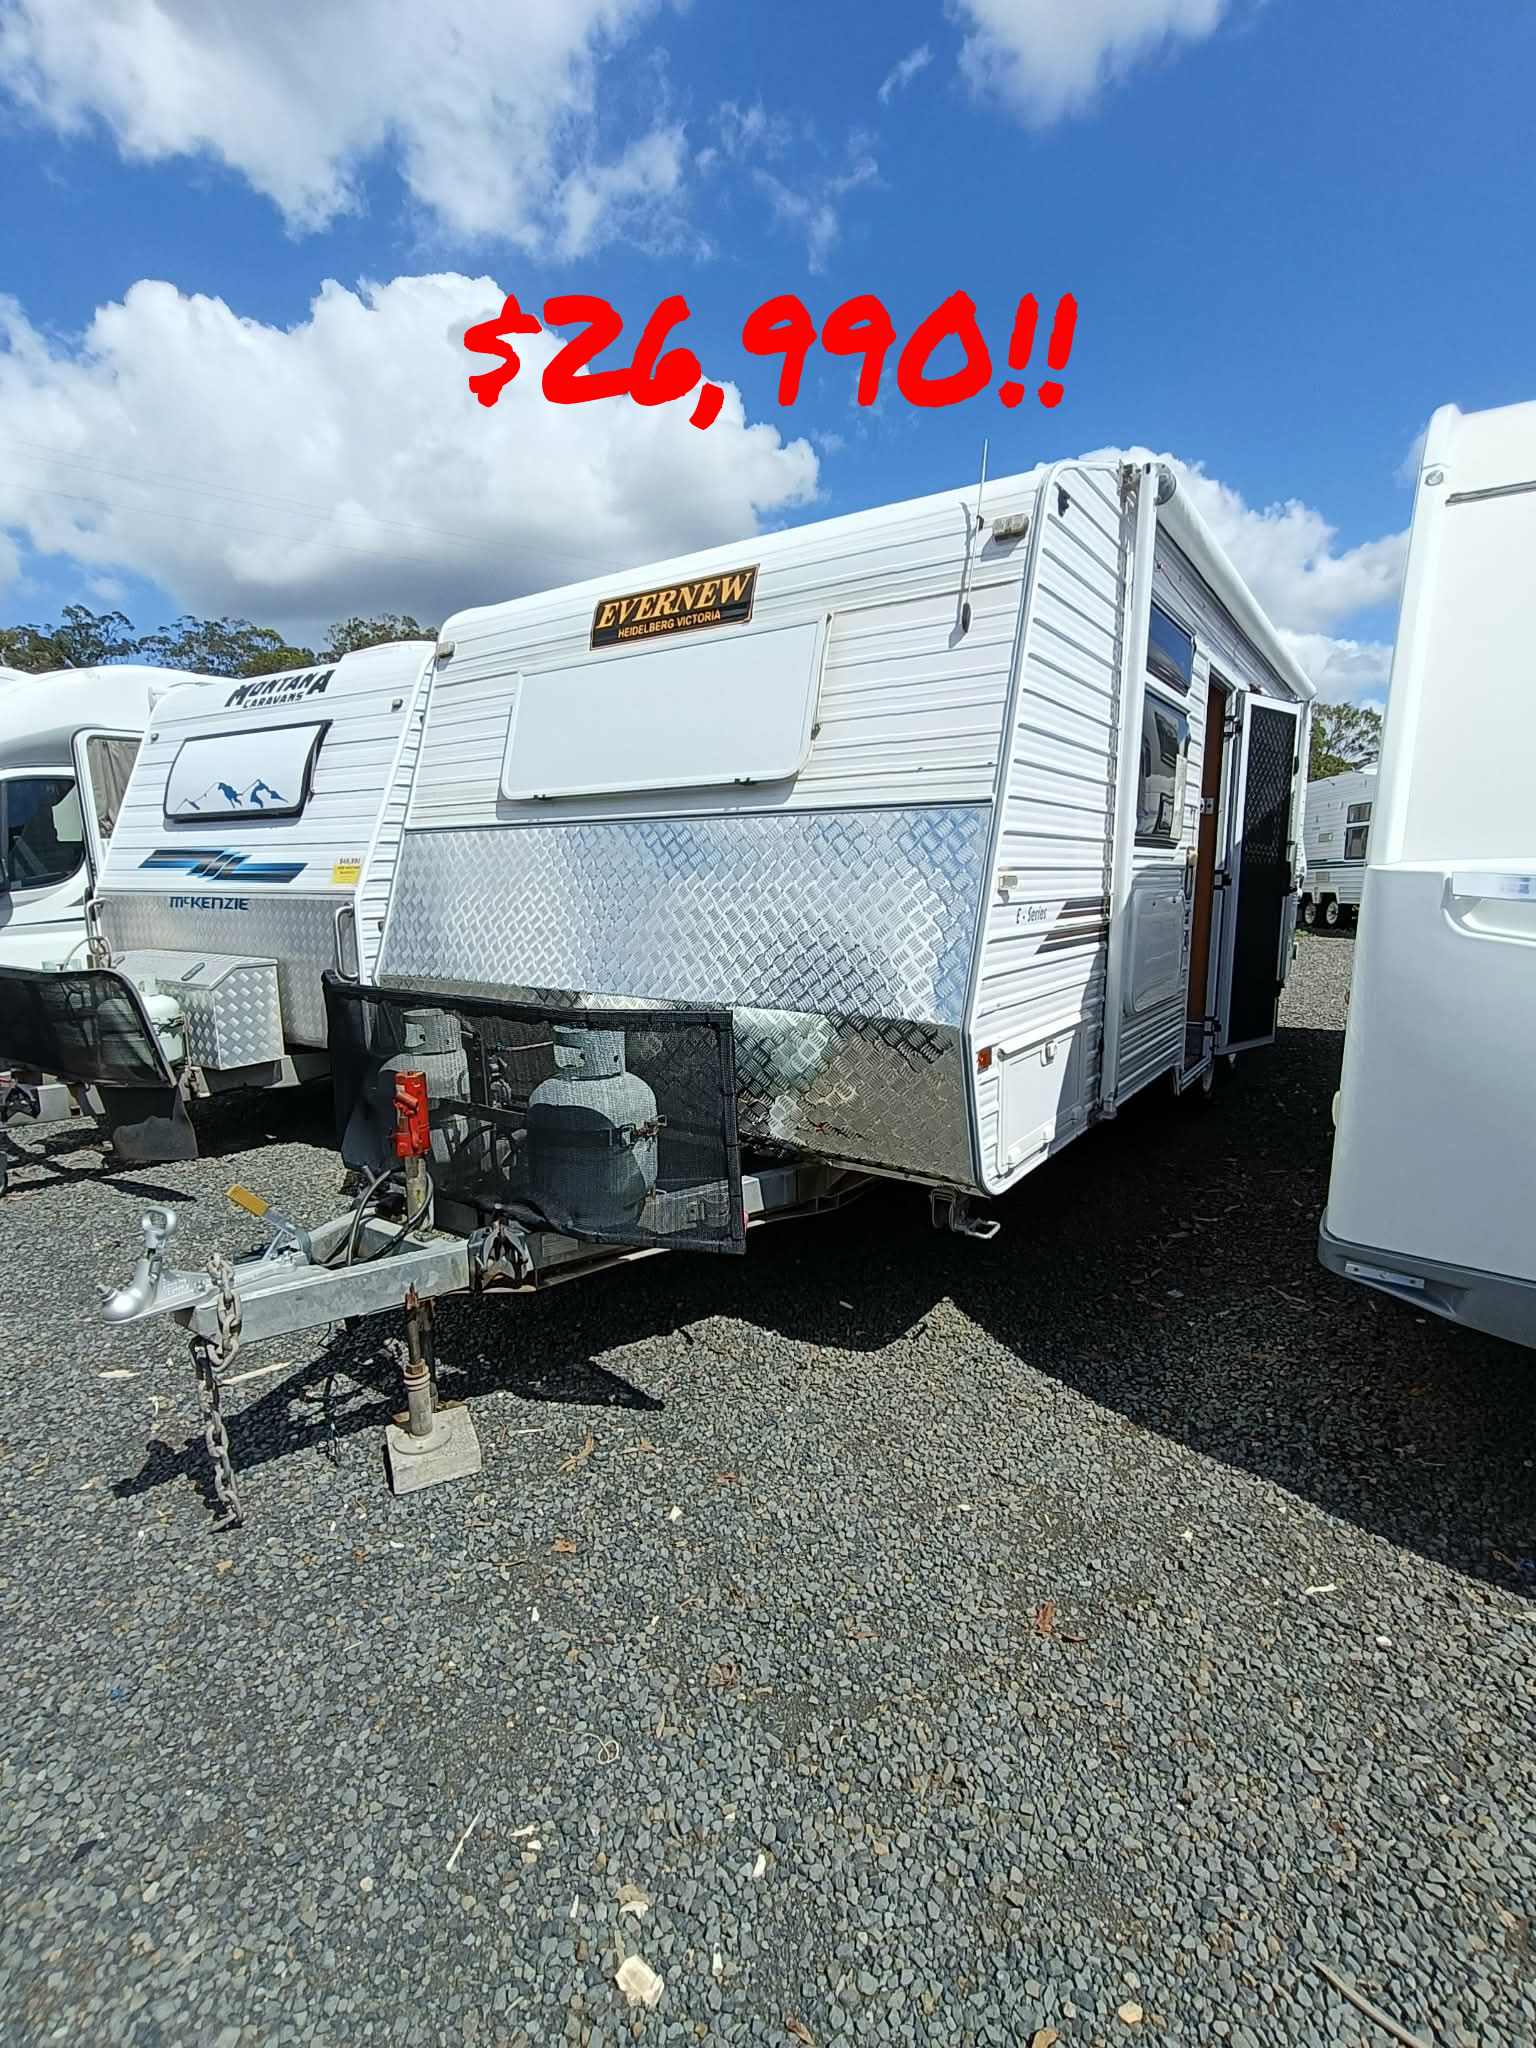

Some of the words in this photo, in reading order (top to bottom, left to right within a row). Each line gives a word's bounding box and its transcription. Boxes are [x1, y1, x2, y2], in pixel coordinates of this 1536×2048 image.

[596, 573, 752, 628] EVERNEW
[618, 620, 675, 639] HEIDELBERG
[677, 609, 721, 627] VICTORIA
[224, 669, 336, 707] MONTANA
[242, 691, 304, 708] CARAVANS
[1027, 905, 1048, 922] Series
